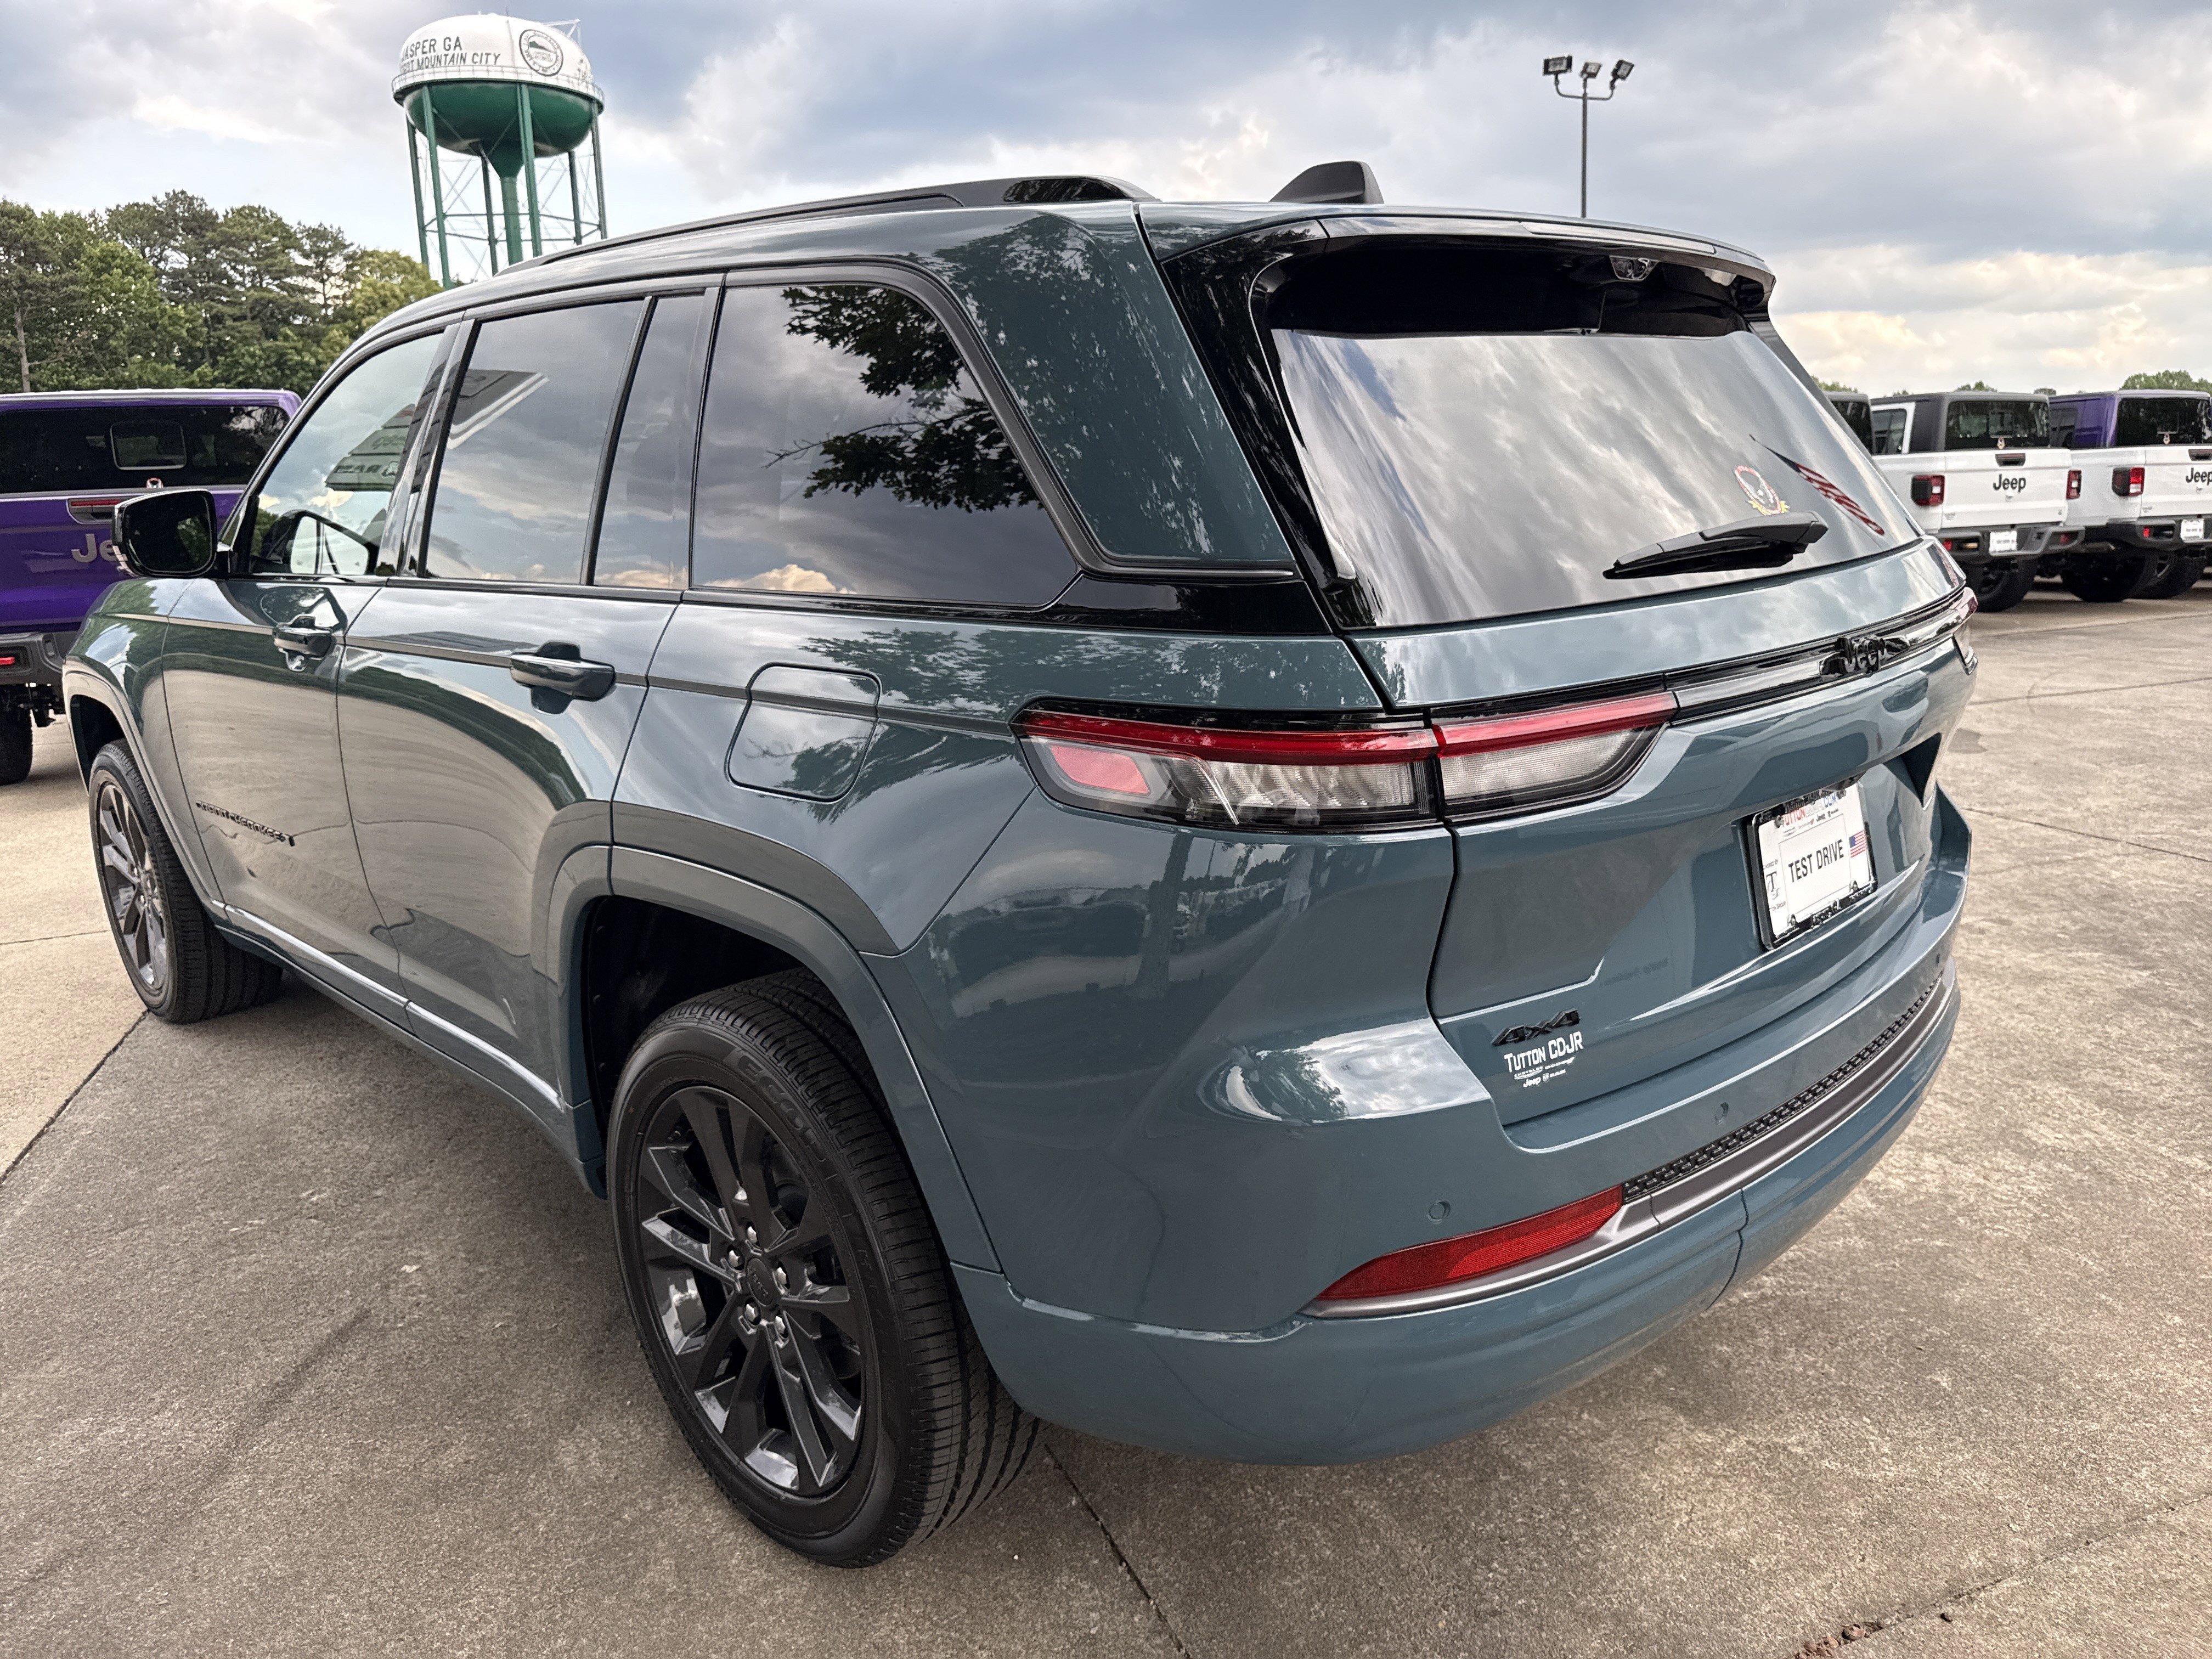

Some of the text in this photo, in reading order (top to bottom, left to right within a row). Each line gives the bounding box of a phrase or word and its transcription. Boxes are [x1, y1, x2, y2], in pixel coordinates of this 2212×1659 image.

[443, 36, 462, 52] GA
[417, 52, 467, 70] MOUNTAIN
[472, 52, 501, 65] CITY
[1993, 473, 2027, 494] Jeep
[70, 533, 119, 563] Je
[1788, 839, 1844, 883] TEST DRIVE
[1504, 1031, 1584, 1073] TUTTON CDJR
[1523, 1076, 1541, 1087] Jeep
